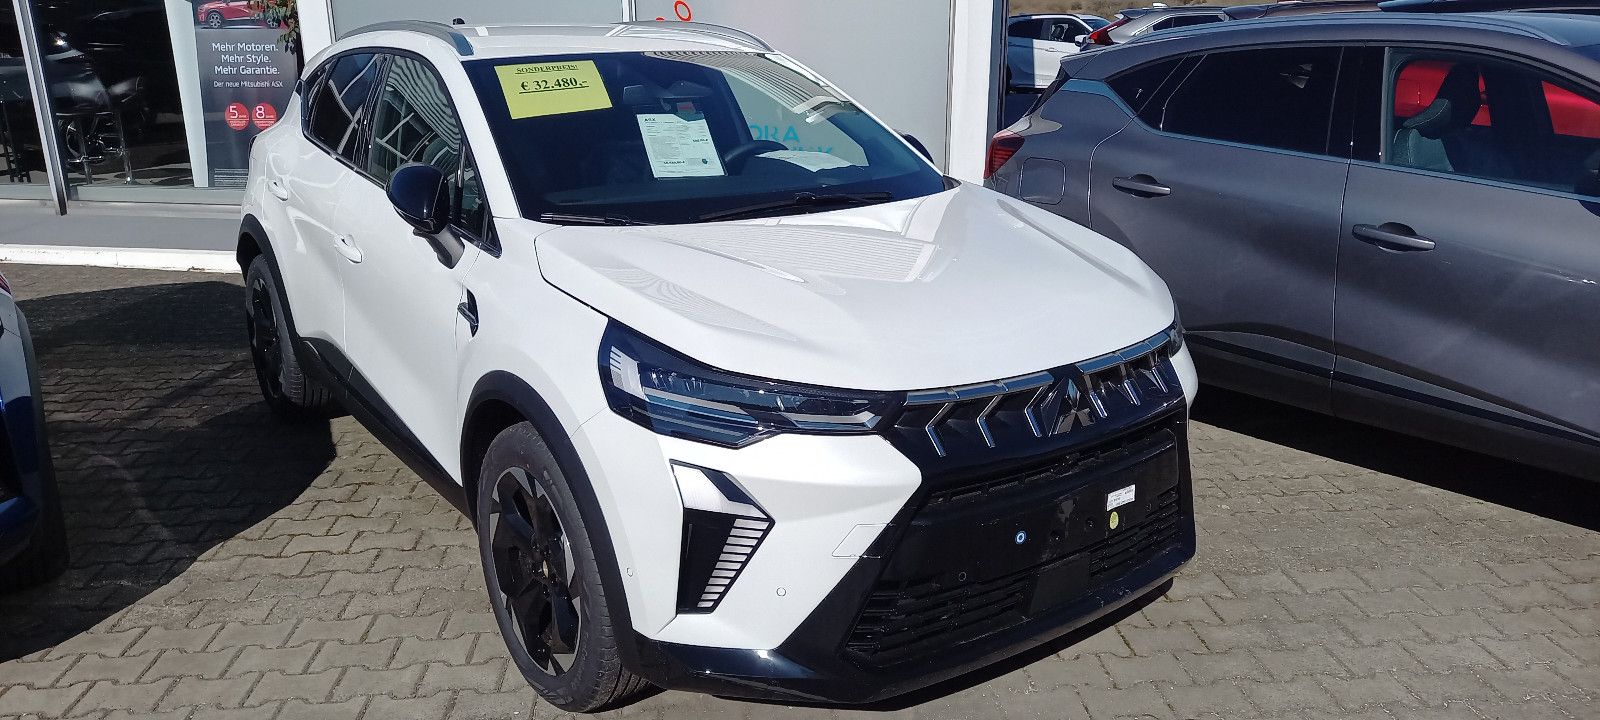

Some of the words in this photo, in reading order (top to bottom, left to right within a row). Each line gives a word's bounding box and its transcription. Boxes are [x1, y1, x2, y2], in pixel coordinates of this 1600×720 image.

[212, 42, 235, 52] Mehr
[237, 42, 279, 52] Motoren.
[221, 54, 244, 63] Mehr
[246, 54, 272, 65] Style.
[214, 65, 238, 75] Mehr
[239, 65, 280, 75] Garantie.
[516, 64, 578, 74] SONDERPREIS!
[213, 80, 224, 88] Der
[240, 80, 270, 88] Mitsubishi
[271, 80, 284, 88] ASX
[520, 81, 530, 91] €
[532, 77, 588, 91] 32.480,-
[229, 105, 239, 119] 5
[255, 105, 265, 119] 8
